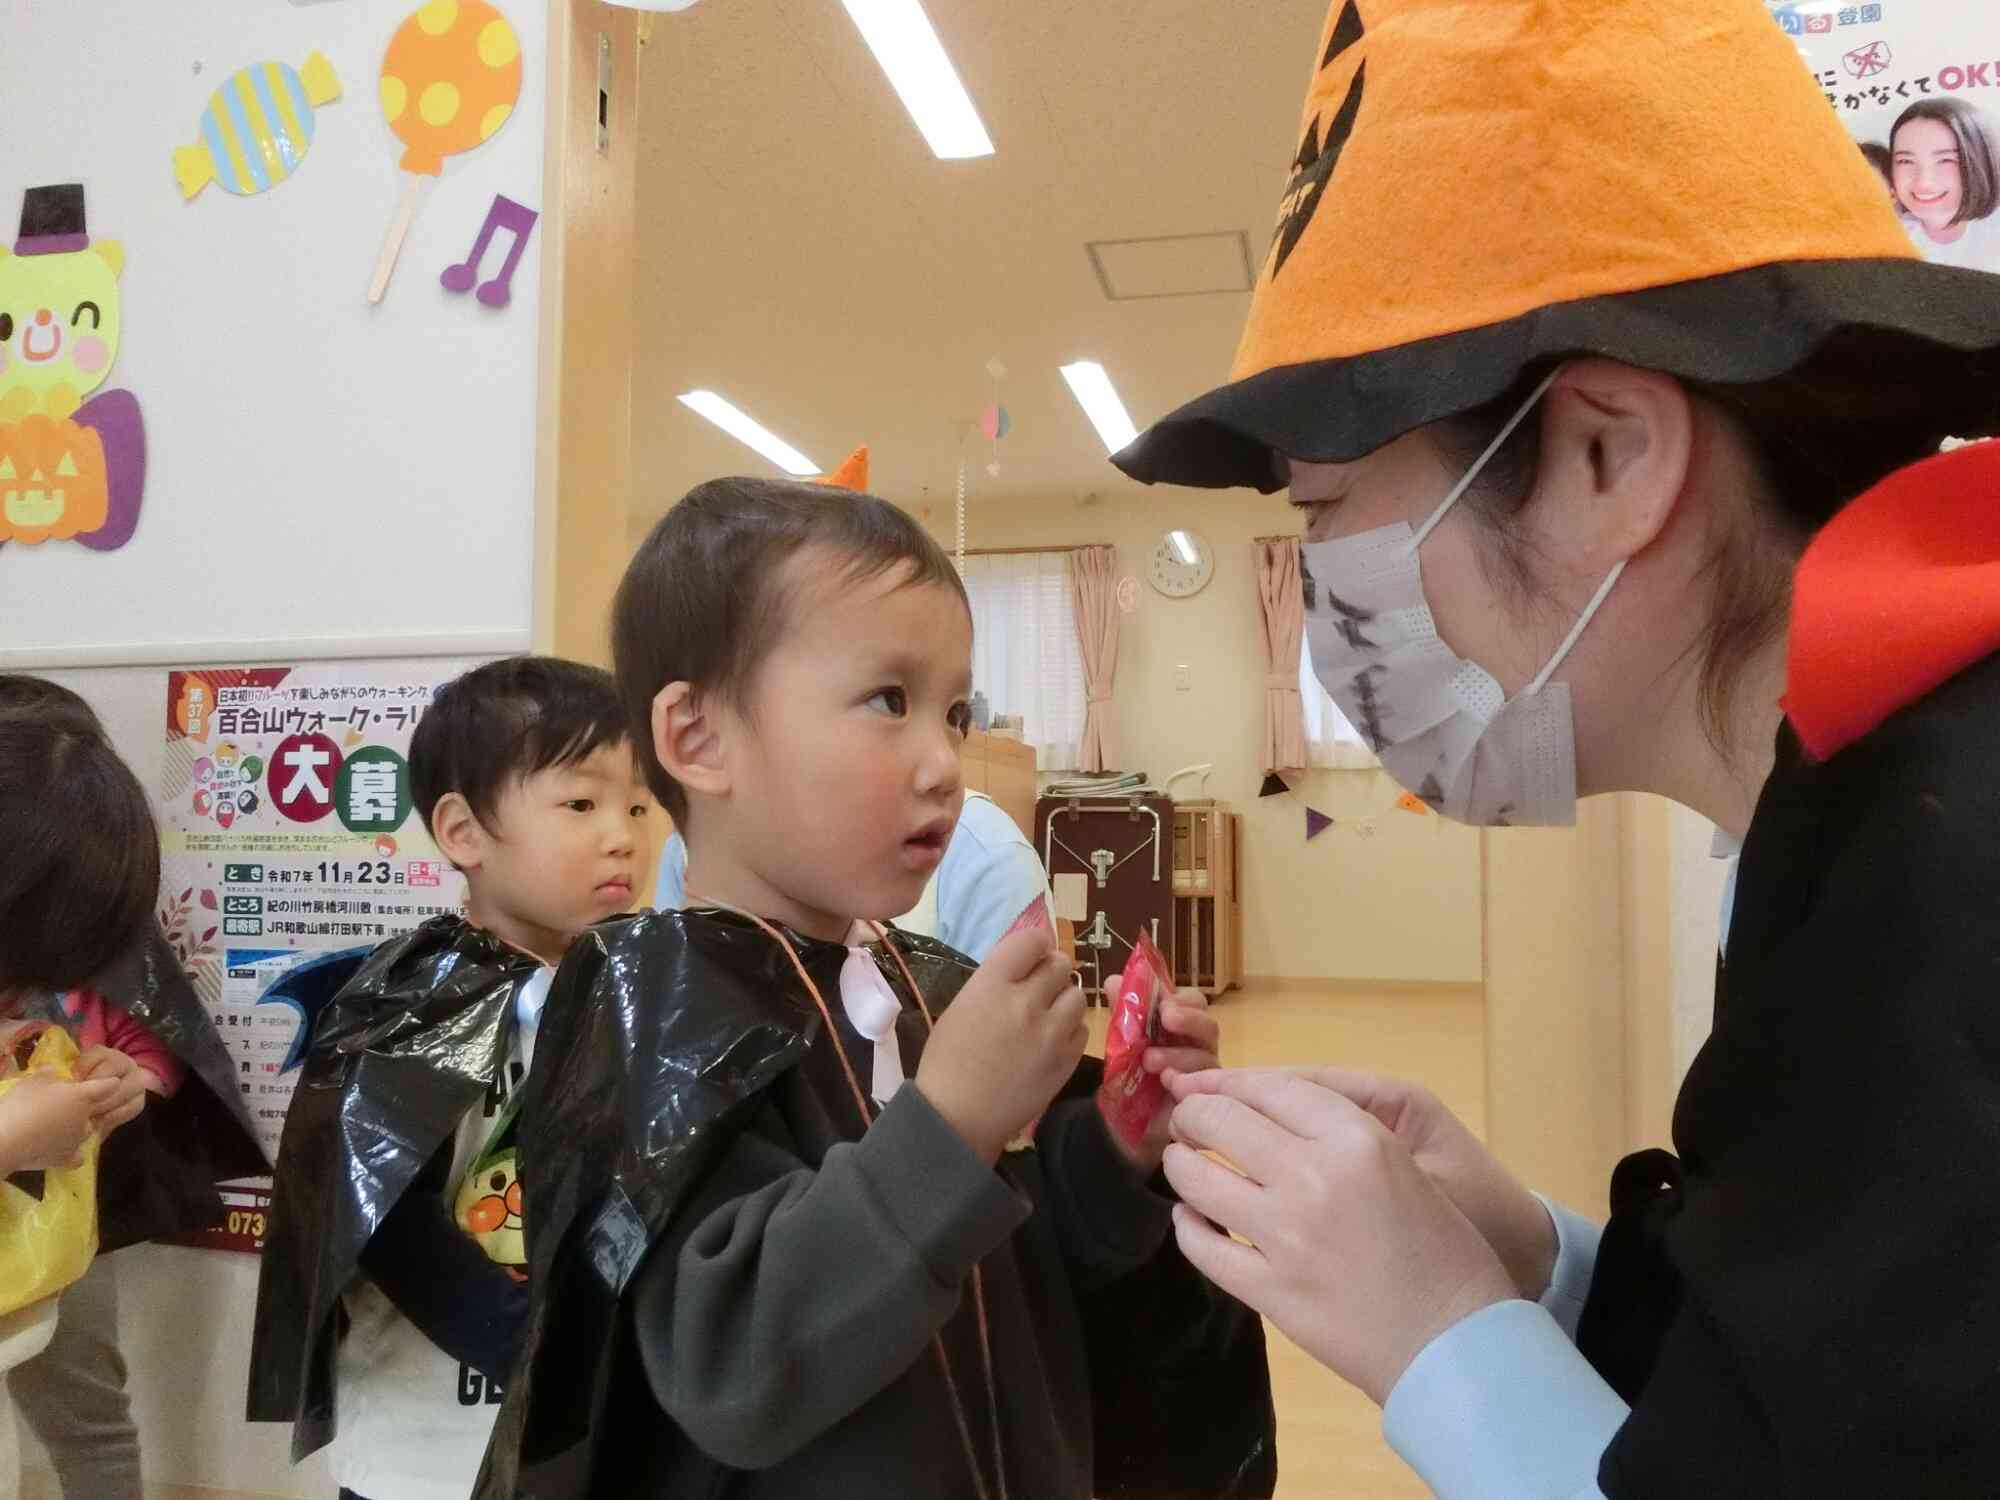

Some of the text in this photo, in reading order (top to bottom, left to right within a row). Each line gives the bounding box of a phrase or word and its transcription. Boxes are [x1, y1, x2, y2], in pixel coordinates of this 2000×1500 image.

[226, 864, 263, 881] とき
[226, 899, 259, 912] ところ
